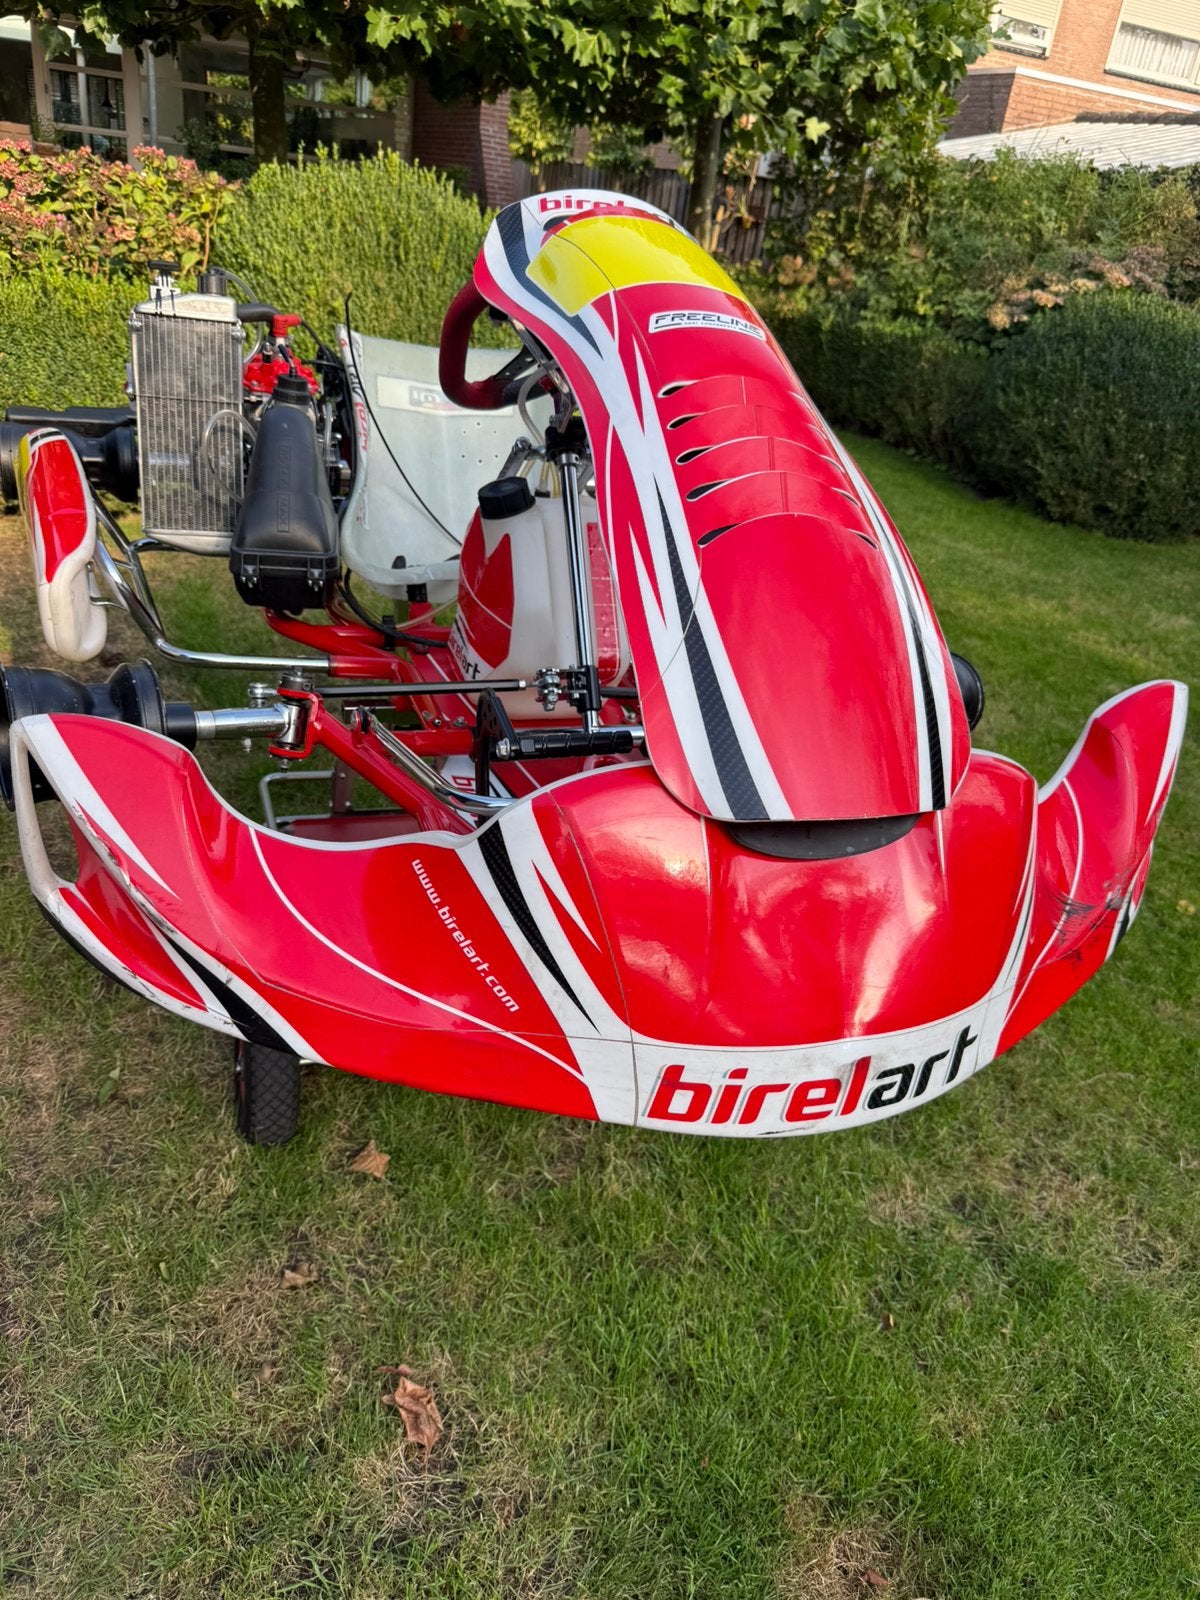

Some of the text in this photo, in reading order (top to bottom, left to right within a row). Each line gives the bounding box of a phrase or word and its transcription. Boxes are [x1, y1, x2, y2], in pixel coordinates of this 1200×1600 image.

[654, 312, 762, 336] FREELINE
[411, 858, 520, 1013] www.birelart.com
[645, 1024, 978, 1125] birelart
